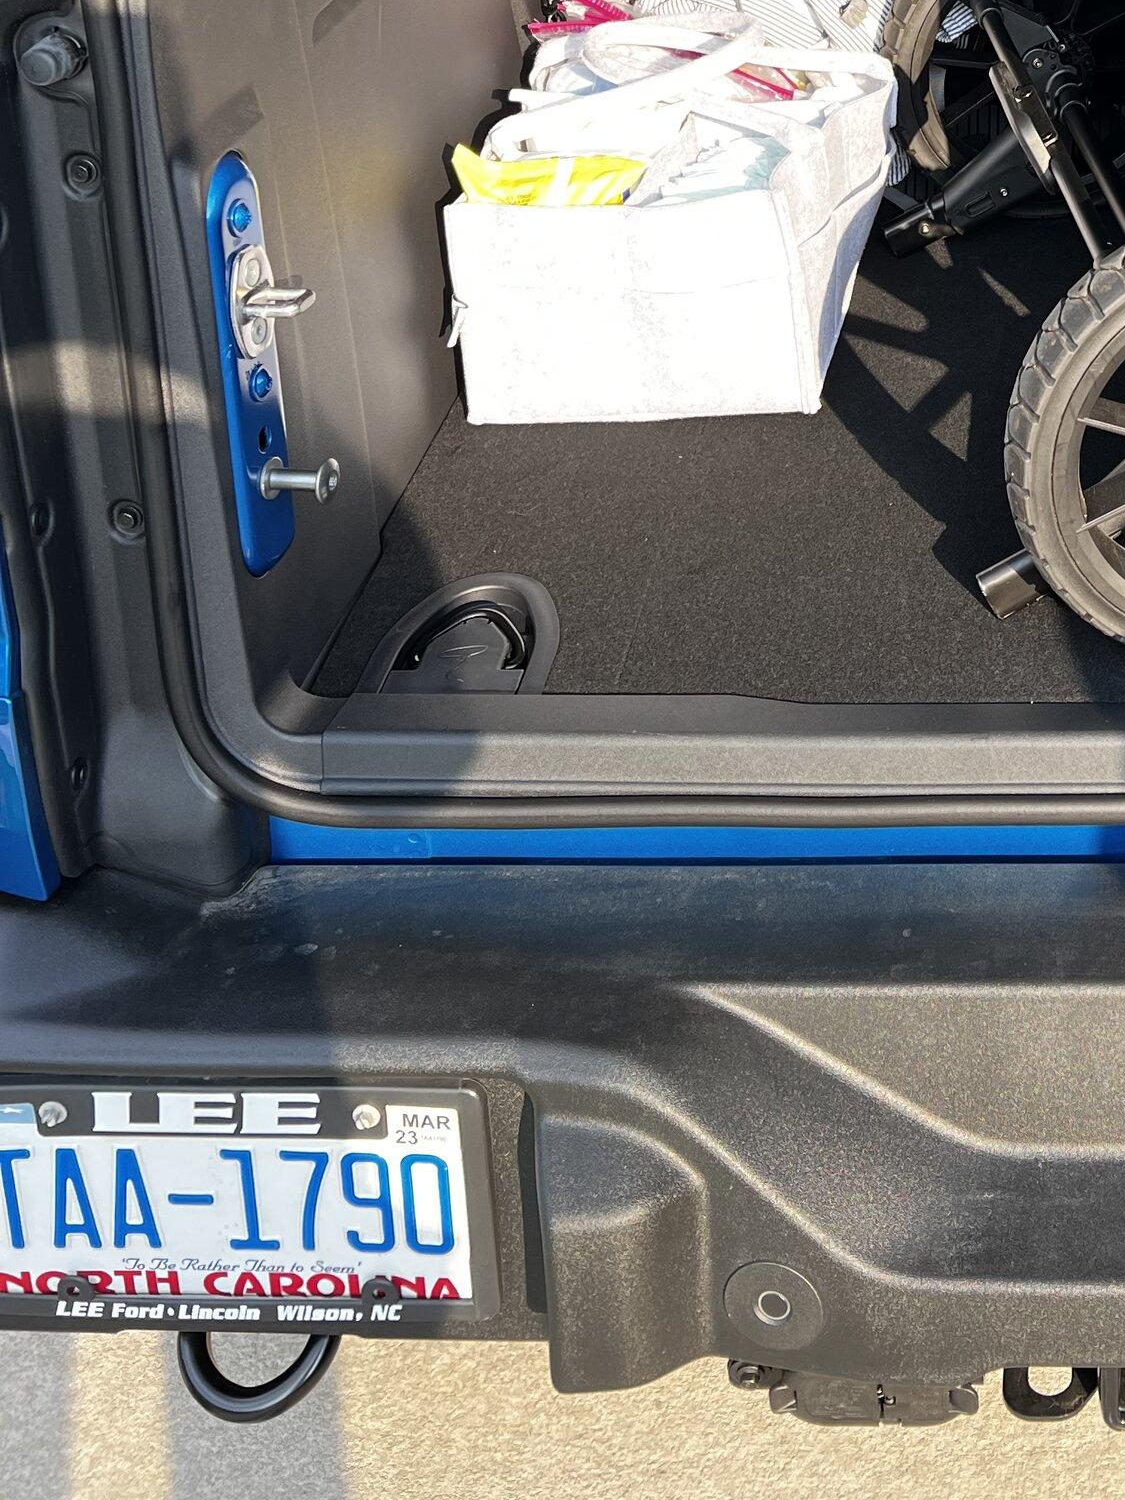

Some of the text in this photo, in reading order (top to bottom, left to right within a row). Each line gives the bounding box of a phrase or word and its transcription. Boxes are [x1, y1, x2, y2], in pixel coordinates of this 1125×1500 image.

[91, 1091, 321, 1135] LEE
[402, 1113, 451, 1130] MAR
[395, 1130, 418, 1145] 23
[151, 1257, 176, 1270] Be
[180, 1258, 240, 1271] Rather
[244, 1259, 284, 1272] Than
[289, 1262, 304, 1273] to
[203, 1272, 461, 1300] CAROLNA
[56, 1300, 105, 1318] LEE
[277, 1304, 363, 1322] Wilson,
[371, 1304, 403, 1321] NC
